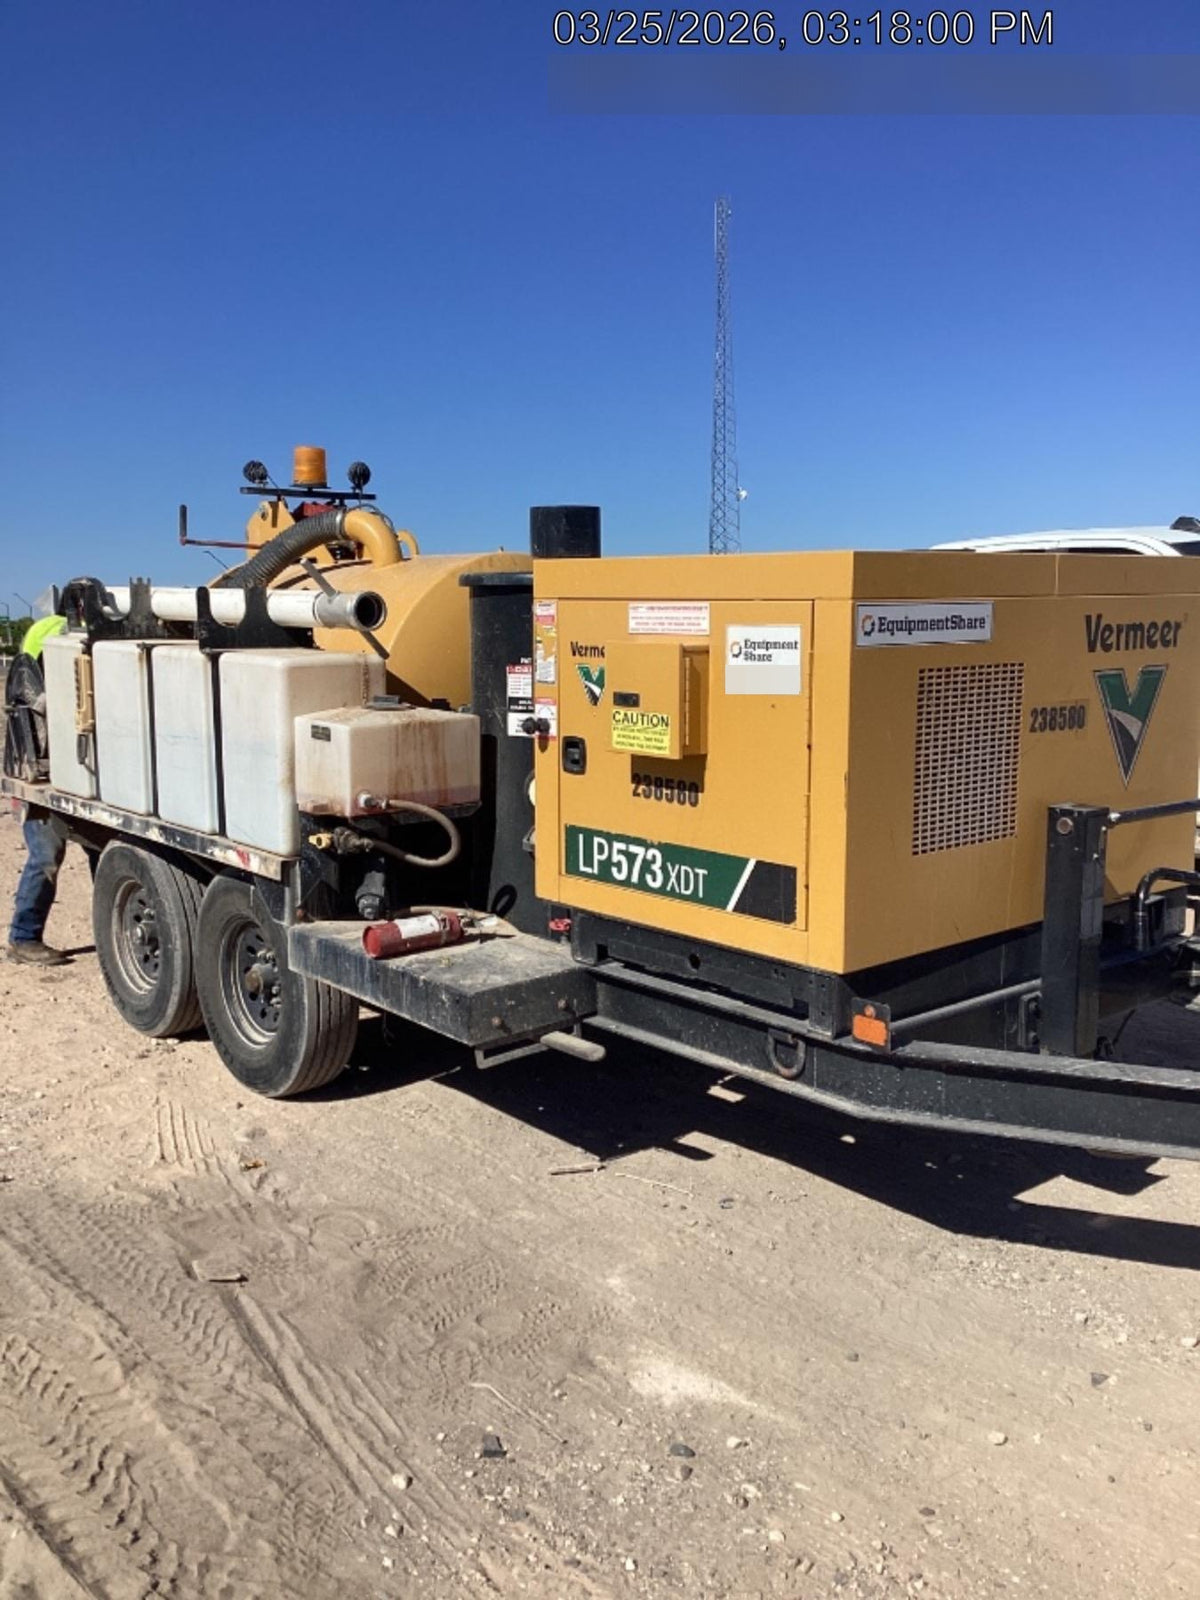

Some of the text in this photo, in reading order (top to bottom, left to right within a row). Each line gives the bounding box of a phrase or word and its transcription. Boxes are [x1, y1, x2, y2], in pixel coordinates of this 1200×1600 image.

[877, 613, 986, 635] EquipmentShare
[1085, 612, 1182, 653] Vermeer
[743, 638, 799, 651] Equipment
[743, 650, 773, 662] Share
[612, 710, 670, 728] CAUTION
[1029, 704, 1087, 733] 238580
[632, 772, 700, 808] 238580
